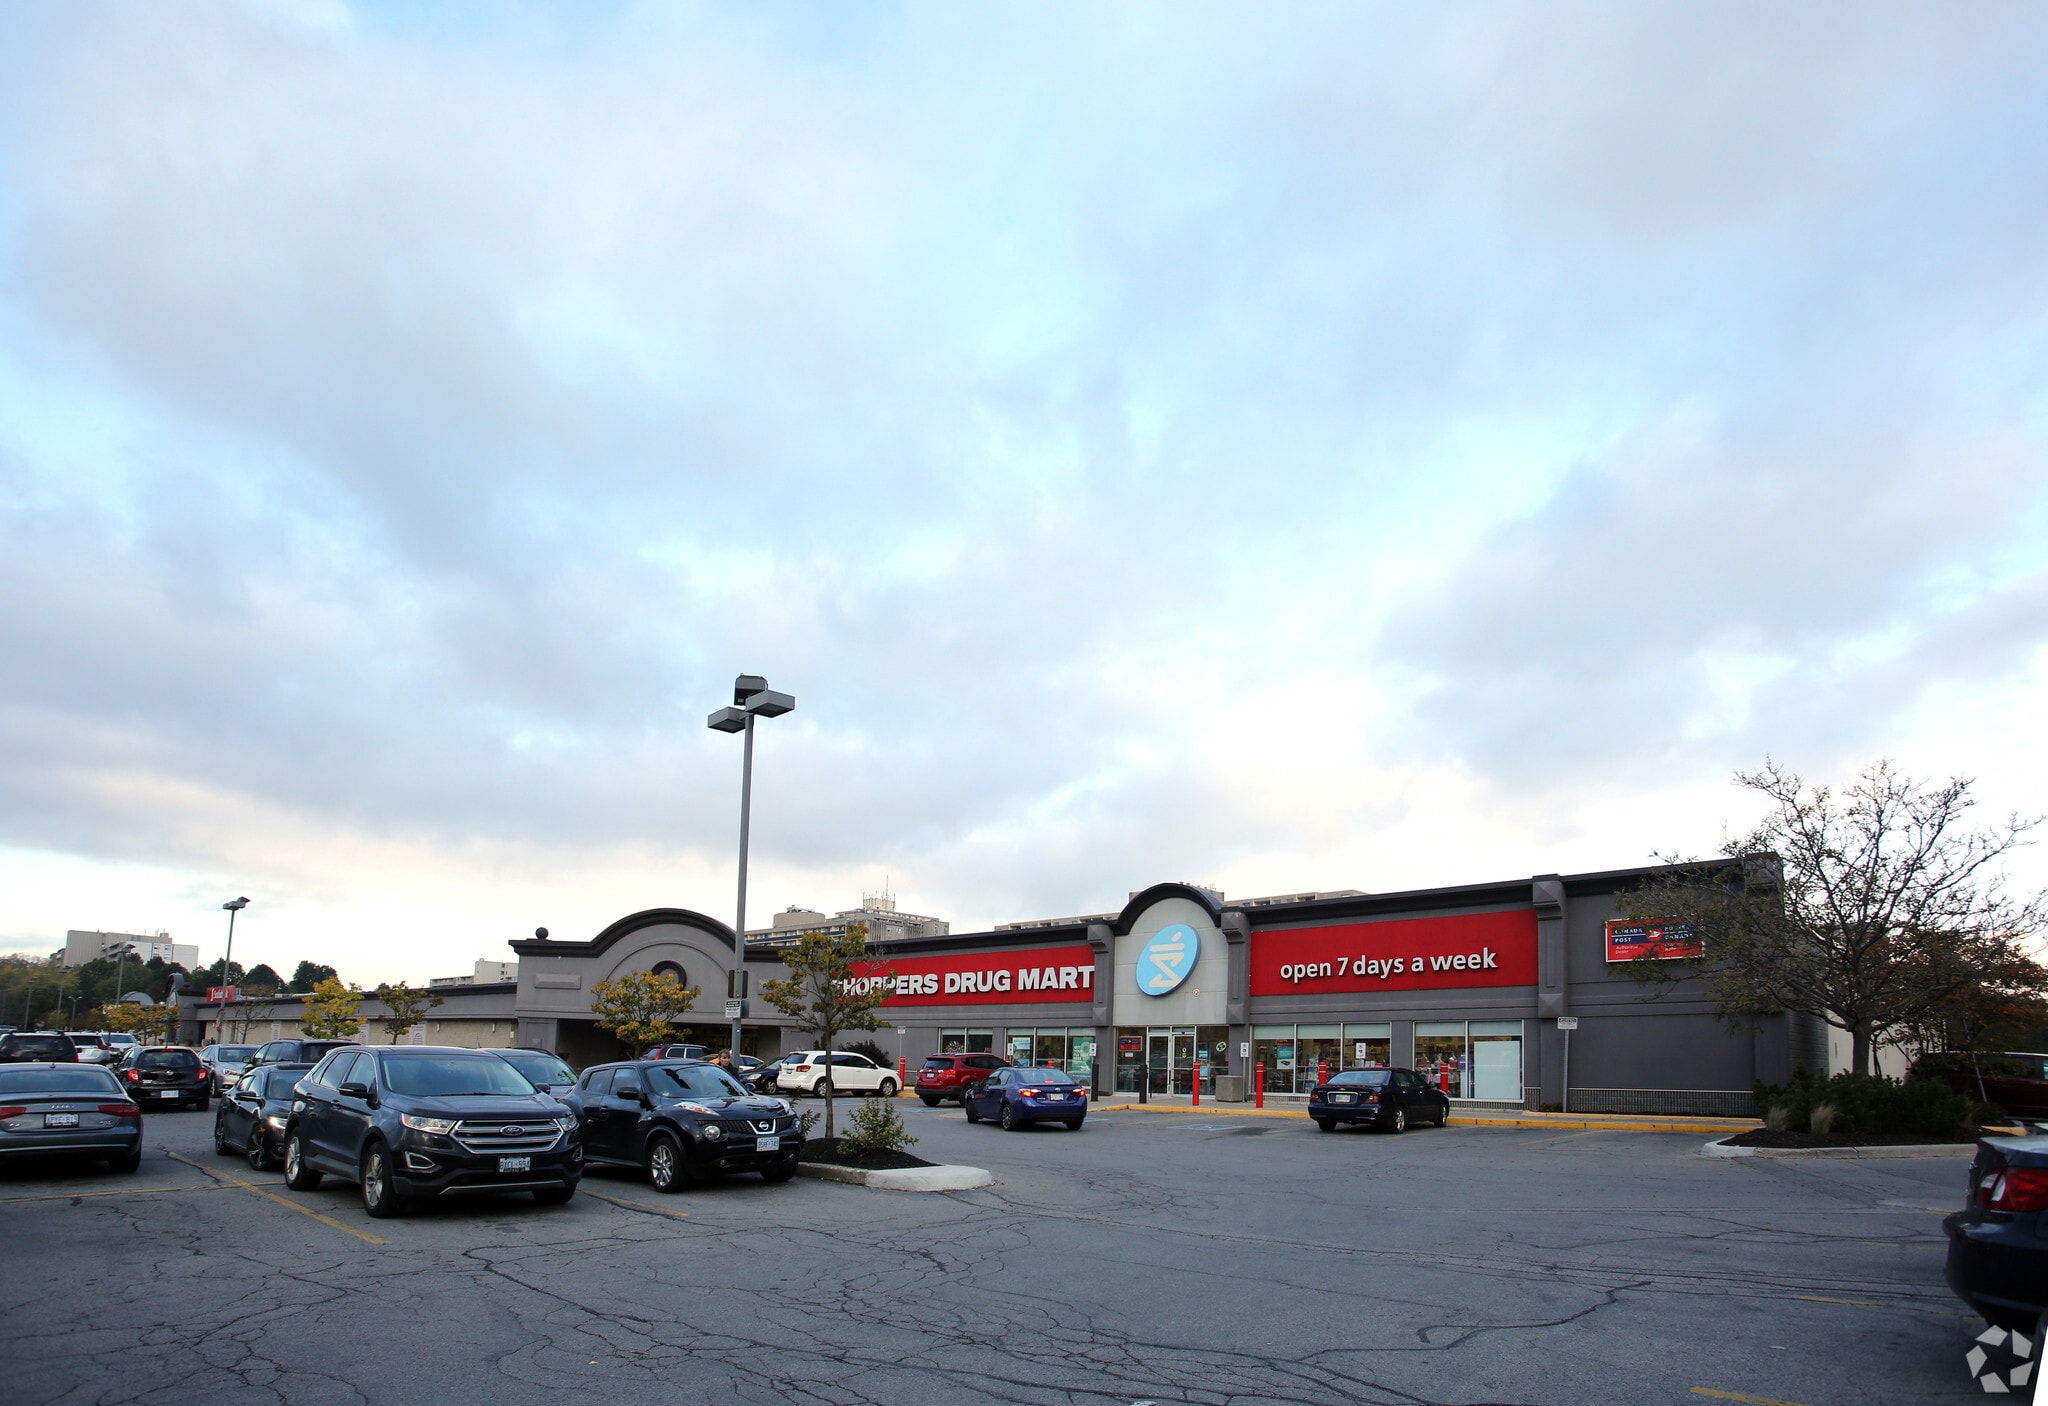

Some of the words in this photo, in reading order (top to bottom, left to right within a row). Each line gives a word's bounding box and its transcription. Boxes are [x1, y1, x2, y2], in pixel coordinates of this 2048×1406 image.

[831, 973, 939, 996] HOPPERS
[944, 969, 1011, 993] DRUG
[1018, 965, 1095, 990] MART
[1280, 961, 1332, 984] open
[1336, 956, 1349, 976] 7
[1352, 954, 1404, 979] days
[1411, 956, 1424, 972] a
[1430, 947, 1498, 971] week
